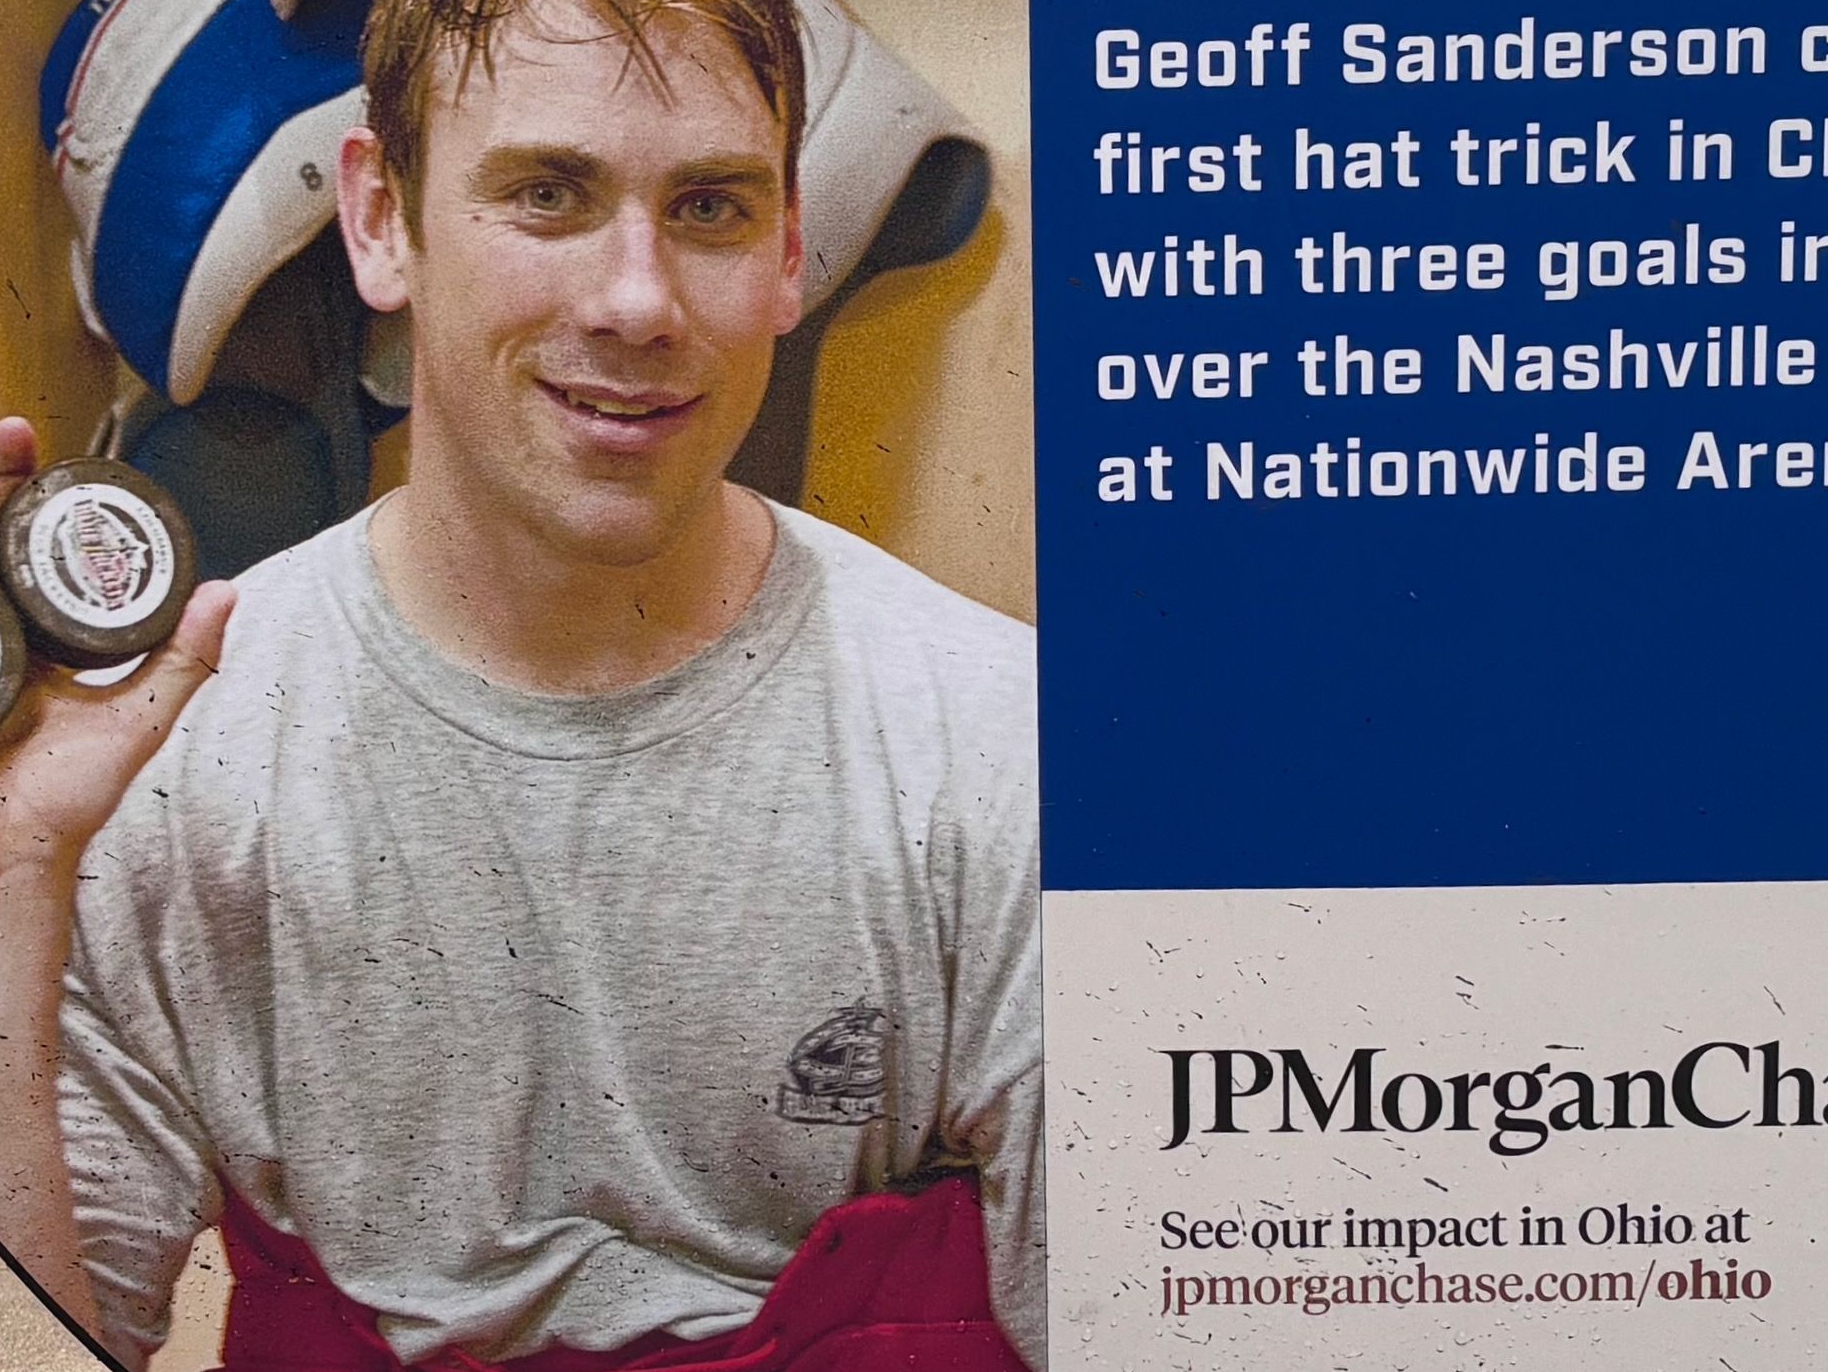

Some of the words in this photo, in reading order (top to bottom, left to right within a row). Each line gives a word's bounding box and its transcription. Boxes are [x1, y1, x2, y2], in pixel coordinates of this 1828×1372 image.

[1096, 23, 1311, 89] Geoff
[1343, 17, 1766, 84] Sanderson
[1094, 133, 1262, 194] first
[1296, 129, 1420, 190] hat
[1451, 121, 1636, 186] trick
[1670, 120, 1733, 181] in
[1095, 235, 1263, 298] with
[1295, 232, 1505, 294] three
[1540, 224, 1746, 301] goals
[1099, 353, 1269, 400] over
[1298, 335, 1422, 396] the
[1458, 326, 1815, 393] Nashville
[1099, 447, 1173, 502] at
[1208, 432, 1645, 500] Nationwide
[1160, 1211, 1240, 1250] See
[1251, 1219, 1331, 1248] our
[1343, 1207, 1507, 1258] impact
[1518, 1205, 1567, 1246] in
[1578, 1202, 1692, 1245] Ohio
[1704, 1207, 1751, 1243] at
[1160, 1258, 1772, 1316] jpmorganchase.com/ohio
